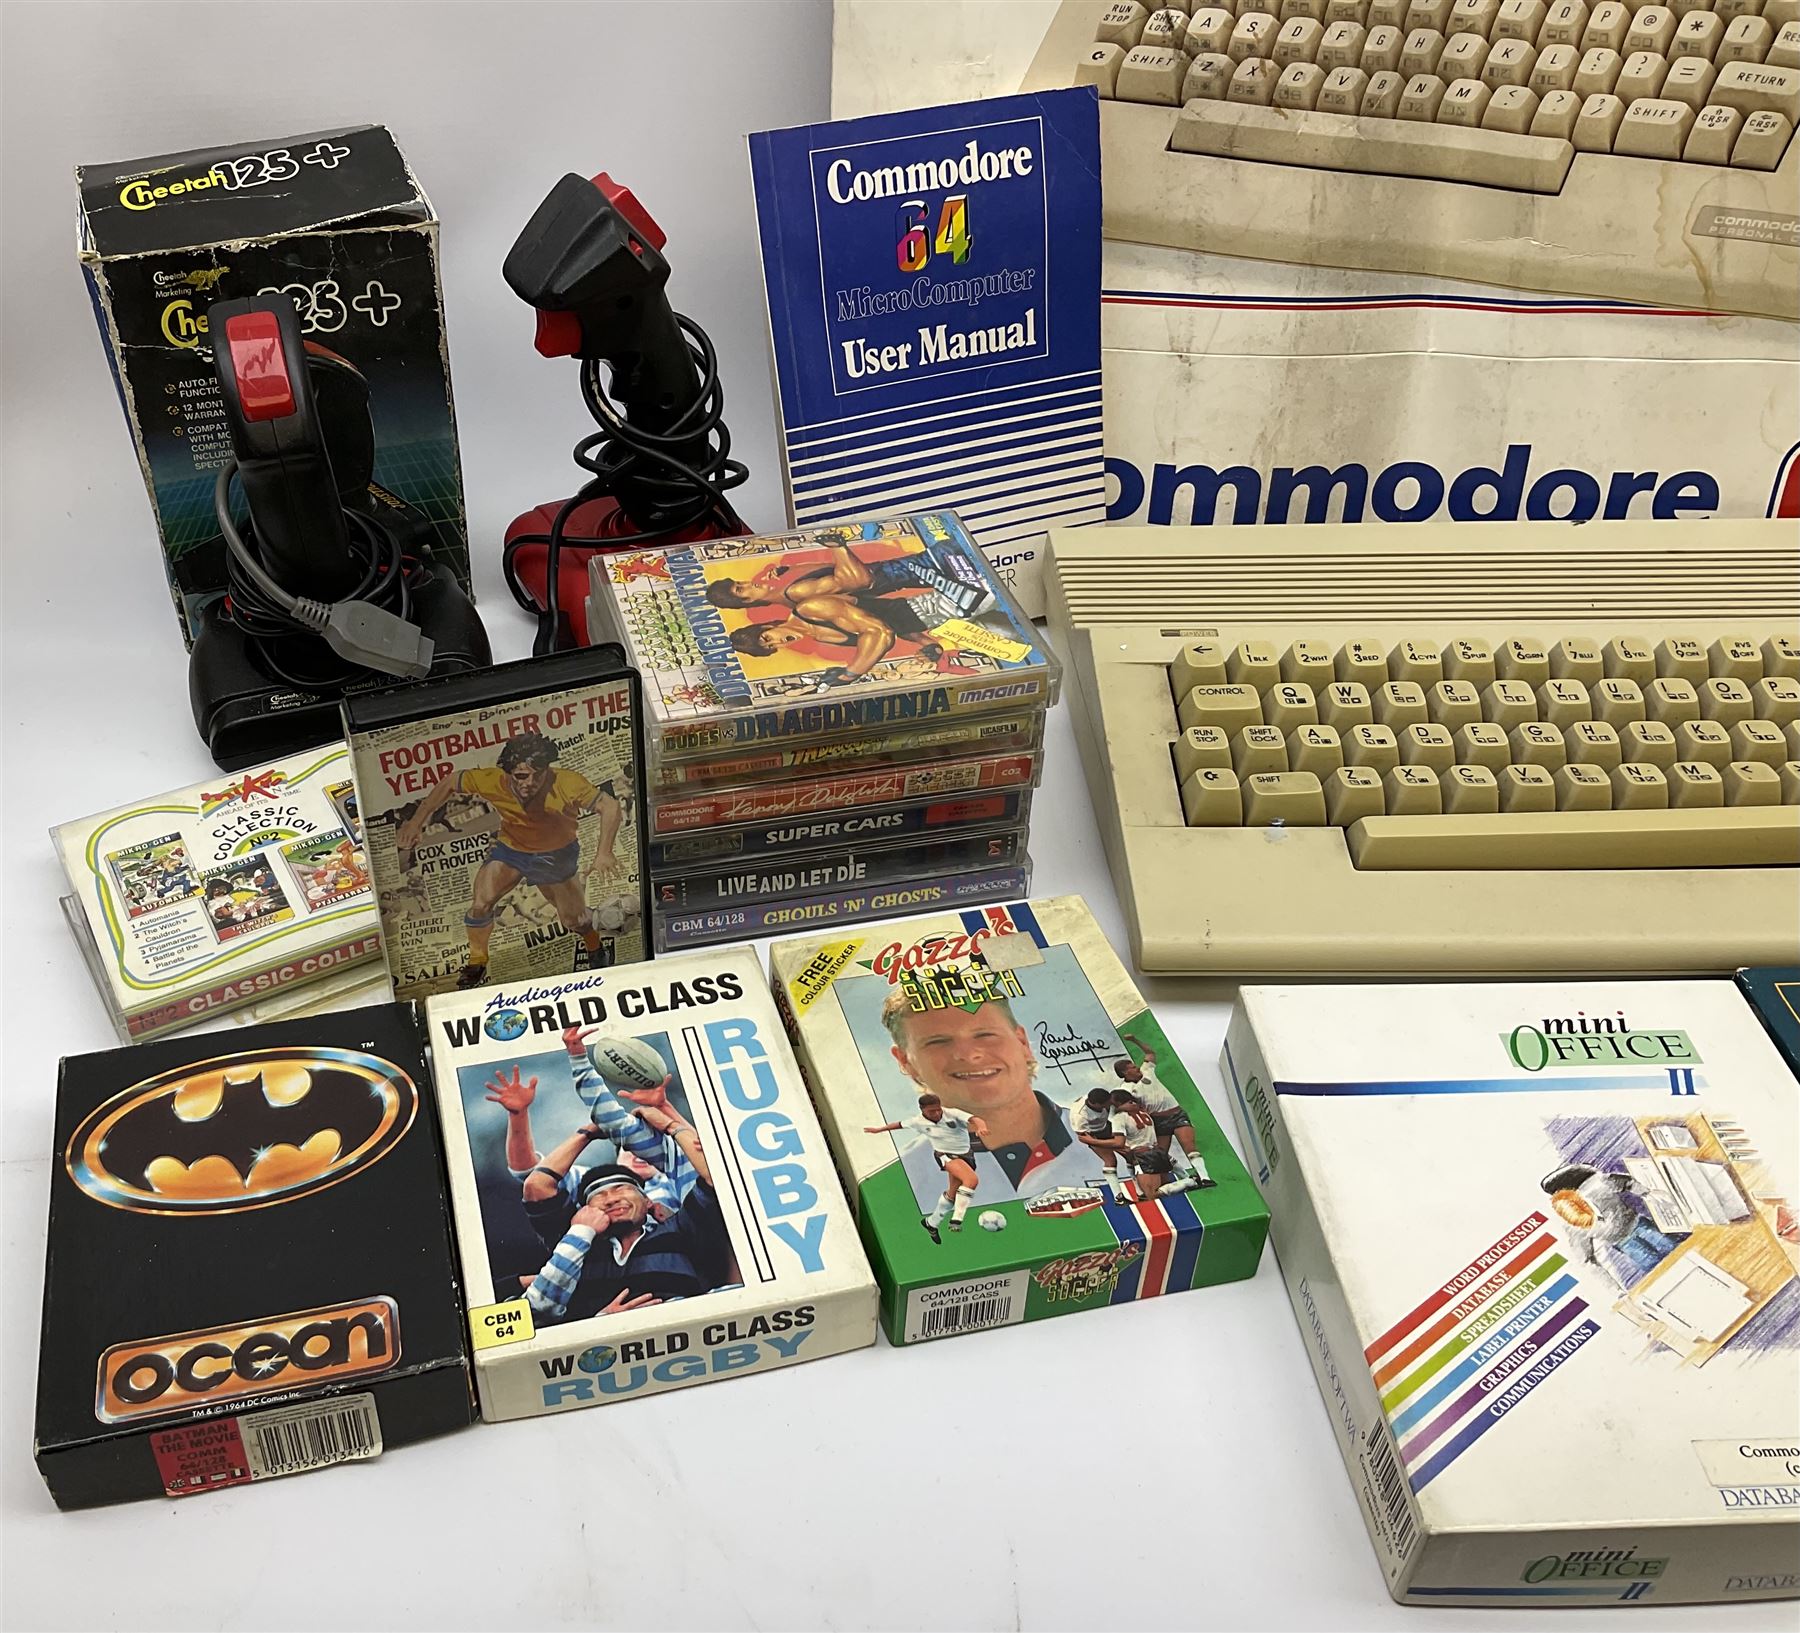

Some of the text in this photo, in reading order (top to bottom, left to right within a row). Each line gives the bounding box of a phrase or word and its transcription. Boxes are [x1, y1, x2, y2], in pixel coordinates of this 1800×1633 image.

[1103, 13, 1130, 23] STOP
[1112, 4, 1132, 13] RUN
[1130, 54, 1175, 66] SHIFT
[1737, 72, 1787, 87] RETURN
[1633, 106, 1677, 119] SHIFT
[1701, 114, 1730, 123] CRSR
[1749, 119, 1778, 129] CRSR
[827, 140, 1033, 204] Commodore
[120, 169, 229, 211] Cheetah
[896, 194, 973, 272] 64
[153, 271, 187, 285] Cheetah
[156, 287, 192, 298] Marketing
[837, 267, 1035, 322] MicroComputer
[161, 300, 208, 348] Che
[842, 308, 1037, 379] User Manual
[179, 379, 205, 389] AUTO
[182, 400, 223, 412] 12 MONT
[184, 409, 226, 420] WARRAN
[187, 422, 228, 435] COMPAT
[189, 432, 214, 443] WITH
[191, 441, 232, 453] COMPUT
[1103, 444, 1720, 525] ommodore
[1198, 687, 1245, 696] CONTROL
[663, 727, 721, 752] DUDES
[735, 686, 951, 742] DRAGONNINJA
[958, 681, 1039, 704] IMAGINE
[379, 713, 540, 774] FOOTBALLER
[546, 702, 577, 729] OF
[582, 689, 630, 719] THE
[385, 762, 454, 797] YEAR
[282, 789, 301, 797] TIME
[212, 806, 299, 838] CLASSIC
[766, 813, 904, 844] SUPER CARS
[213, 816, 318, 861] COLLECTION
[417, 844, 446, 861] COX
[451, 833, 489, 854] STAYS
[421, 861, 436, 875] AT
[717, 857, 866, 897] LIVE AND LET DIE
[315, 886, 371, 909] PYJAMARAM
[672, 919, 703, 933] CBM
[707, 913, 745, 928] 64/128
[763, 902, 838, 925] GHOULS
[871, 887, 941, 909] GHOSTS
[139, 910, 180, 927] Automania
[143, 919, 188, 936] The Witch's
[401, 917, 445, 931] GILBERT
[145, 928, 181, 943] Cauldron
[148, 934, 197, 954] Pyjamarama
[401, 925, 451, 939] IN DEBUT
[401, 938, 423, 948] WIN
[523, 922, 569, 948] INJU
[152, 951, 175, 963] Battle
[186, 943, 199, 952] the
[155, 957, 185, 970] Planets
[188, 965, 295, 1013] CLASSIC
[301, 937, 378, 975] COLLE
[796, 951, 834, 987] FREE
[801, 943, 857, 1006] COLOUR STICKER
[485, 976, 604, 1012] Audiogenic
[442, 972, 743, 1048] WORLD CLASS
[1542, 1010, 1630, 1033] mini
[360, 1041, 375, 1049] TM
[1509, 1024, 1692, 1072] OFFICE
[604, 1048, 656, 1089] GILBERT
[1664, 1068, 1700, 1096] II
[1258, 1087, 1277, 1132] mini
[1245, 1076, 1279, 1170] OFFICE
[703, 1017, 829, 1274] RUGBY
[1443, 1217, 1542, 1297] WORD PROCESSOR
[920, 1278, 1012, 1303] COMMODORE
[970, 1290, 1000, 1301] CASS
[1451, 1270, 1512, 1321] DATABASE
[484, 1310, 522, 1327] CBM
[1460, 1278, 1537, 1344] SPREADSHEET
[496, 1325, 515, 1338] 64
[539, 1305, 816, 1379] WORLD CLASS
[1470, 1295, 1554, 1367] LABEL PRINTER
[112, 1311, 387, 1404] ocean
[542, 1329, 815, 1407] RUGBY
[1299, 1277, 1357, 1445] DATABASE SOFTWA
[1479, 1340, 1538, 1392] GRAPHICS
[1489, 1325, 1593, 1417] COMMUNICATIONS
[192, 1393, 288, 1418] TM 1964 DC Comics
[157, 1432, 239, 1454] THE MOVIE
[161, 1423, 228, 1444] BATMAN
[177, 1446, 227, 1461] COMM
[270, 1456, 318, 1475] 013156
[1565, 1545, 1639, 1561] mini
[1524, 1555, 1662, 1584] OFFICE
[1618, 1582, 1653, 1600] II
